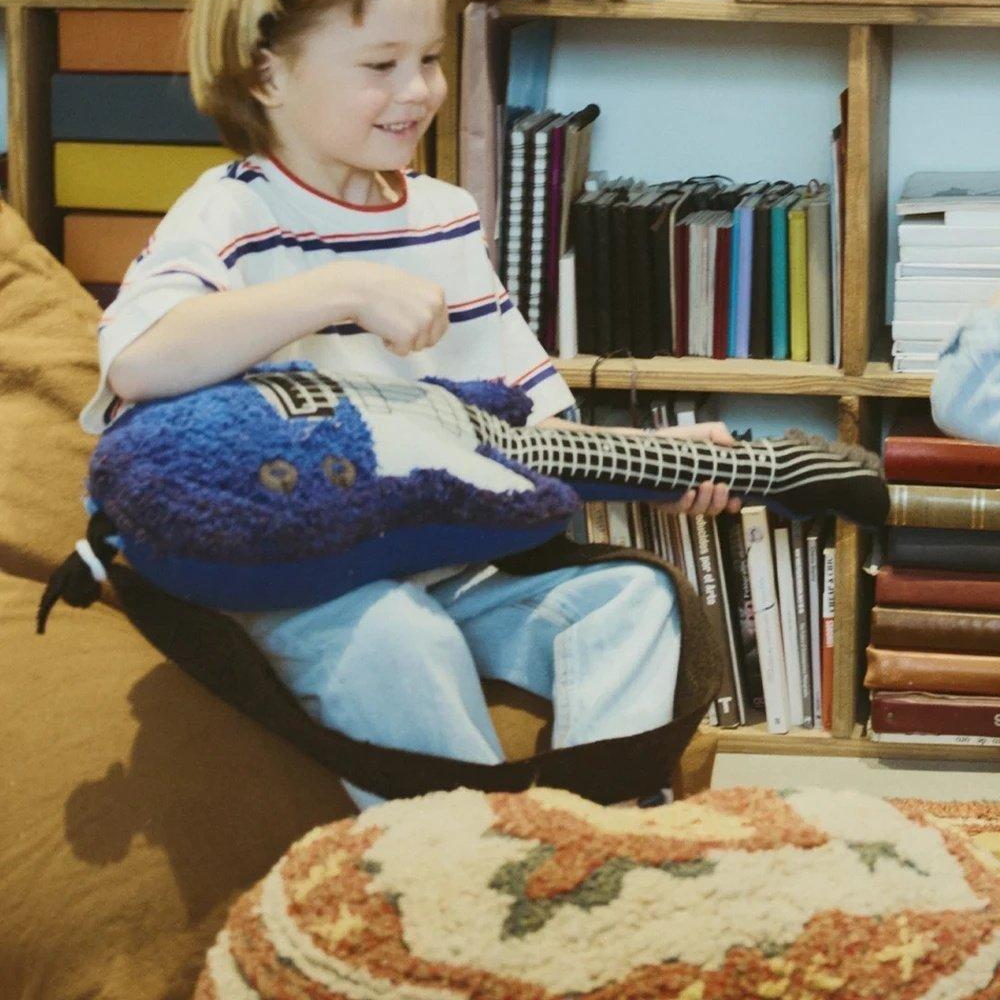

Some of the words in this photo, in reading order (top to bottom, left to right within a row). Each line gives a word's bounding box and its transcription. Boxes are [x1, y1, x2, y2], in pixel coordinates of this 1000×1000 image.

[699, 555, 712, 572] por
[702, 573, 714, 583] el
[705, 583, 717, 605] Arte
